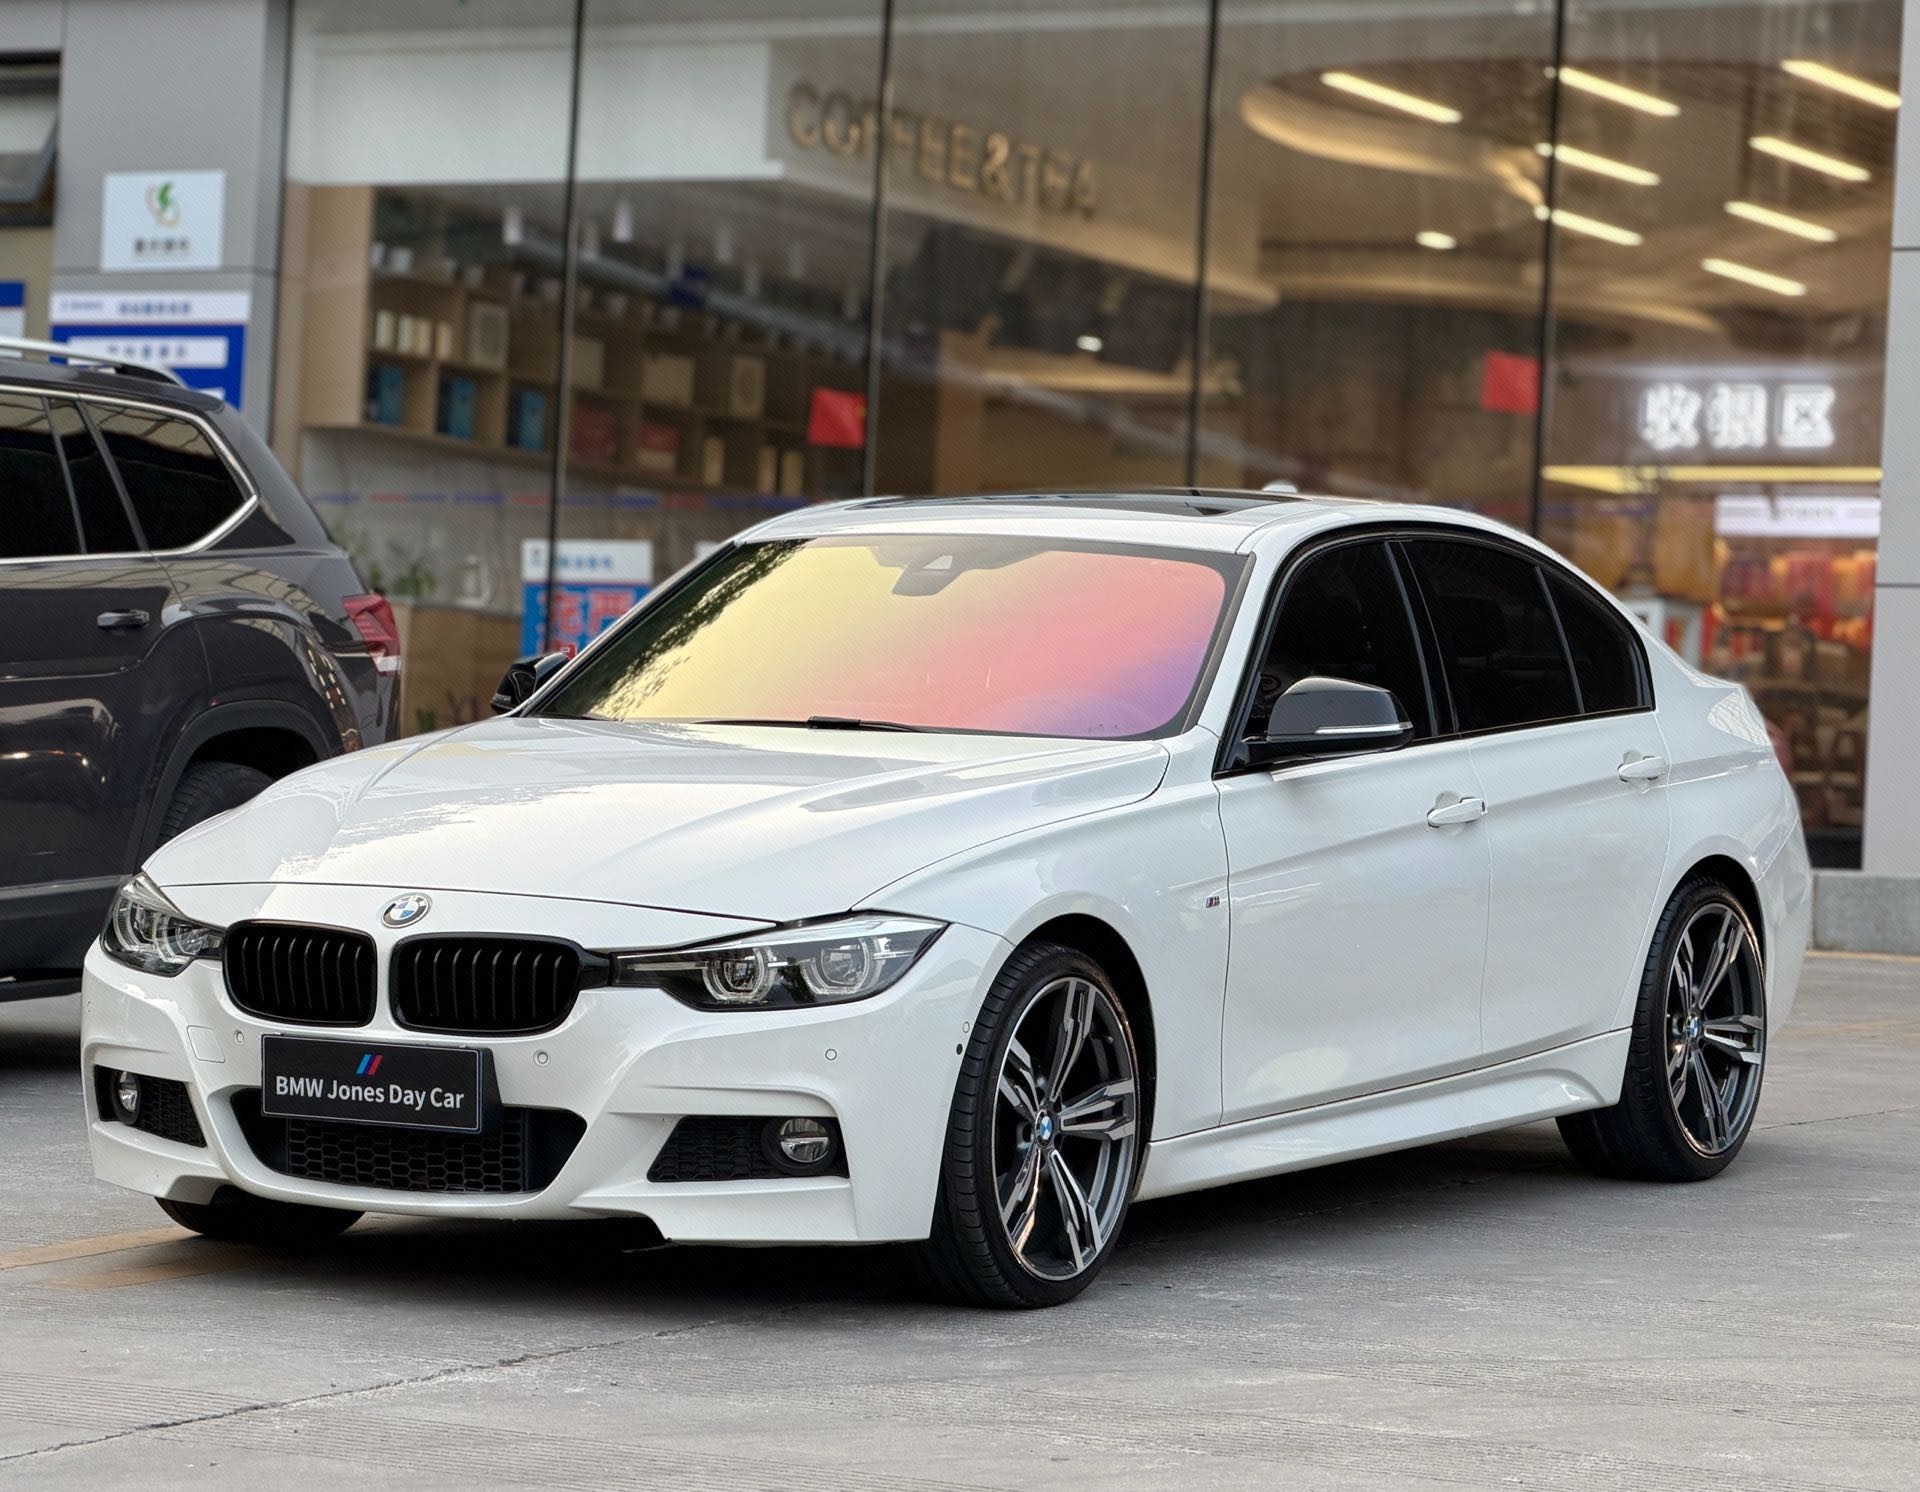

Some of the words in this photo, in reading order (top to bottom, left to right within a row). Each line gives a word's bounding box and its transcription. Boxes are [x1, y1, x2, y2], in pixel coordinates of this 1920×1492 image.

[276, 1076, 323, 1098] BMW
[327, 1080, 385, 1103] Jones
[389, 1085, 425, 1111] Day
[430, 1087, 464, 1109] Car
